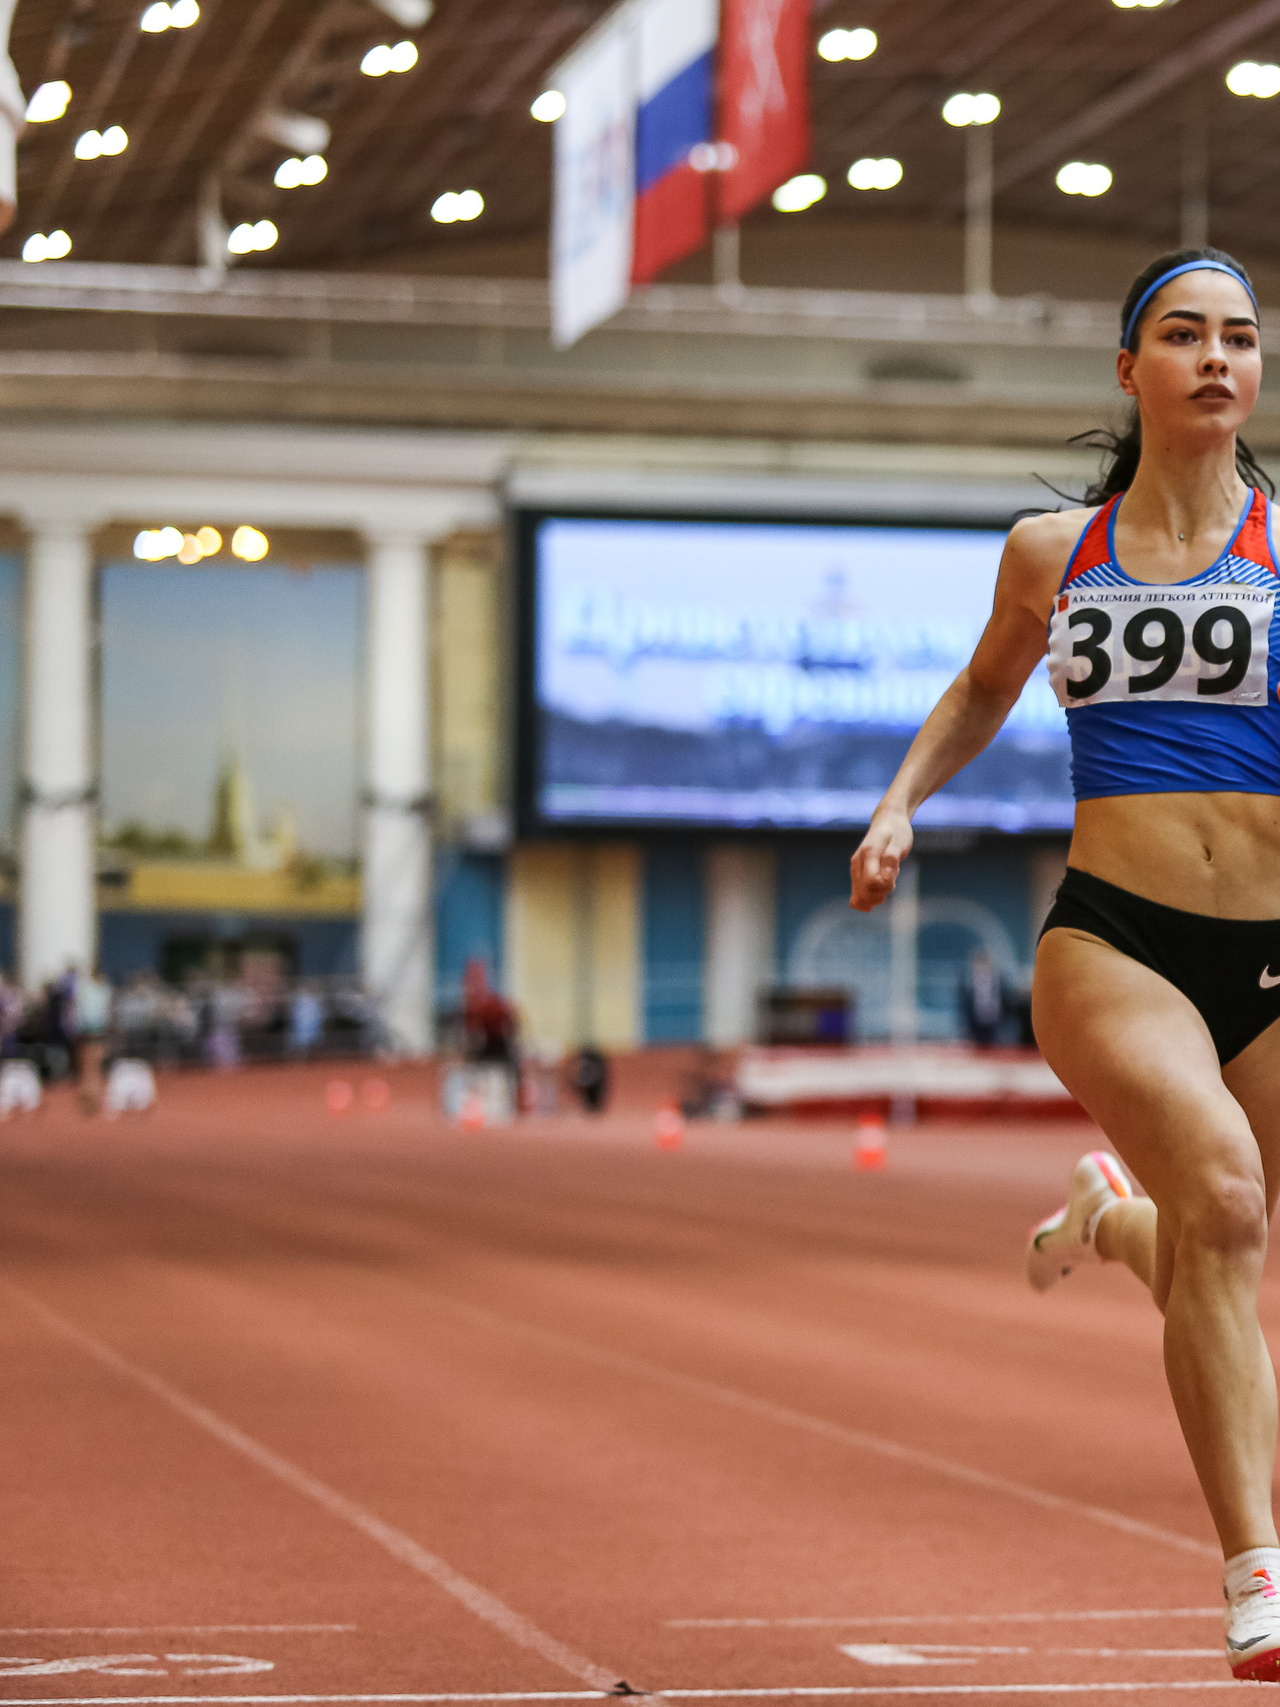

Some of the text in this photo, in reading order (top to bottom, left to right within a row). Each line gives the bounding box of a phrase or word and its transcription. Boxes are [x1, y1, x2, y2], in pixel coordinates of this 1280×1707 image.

[1071, 591, 1270, 605] АКАДЕМИЯ ЛЕГКОЙ АТЛЕТИКИ
[1065, 604, 1252, 700] 399
